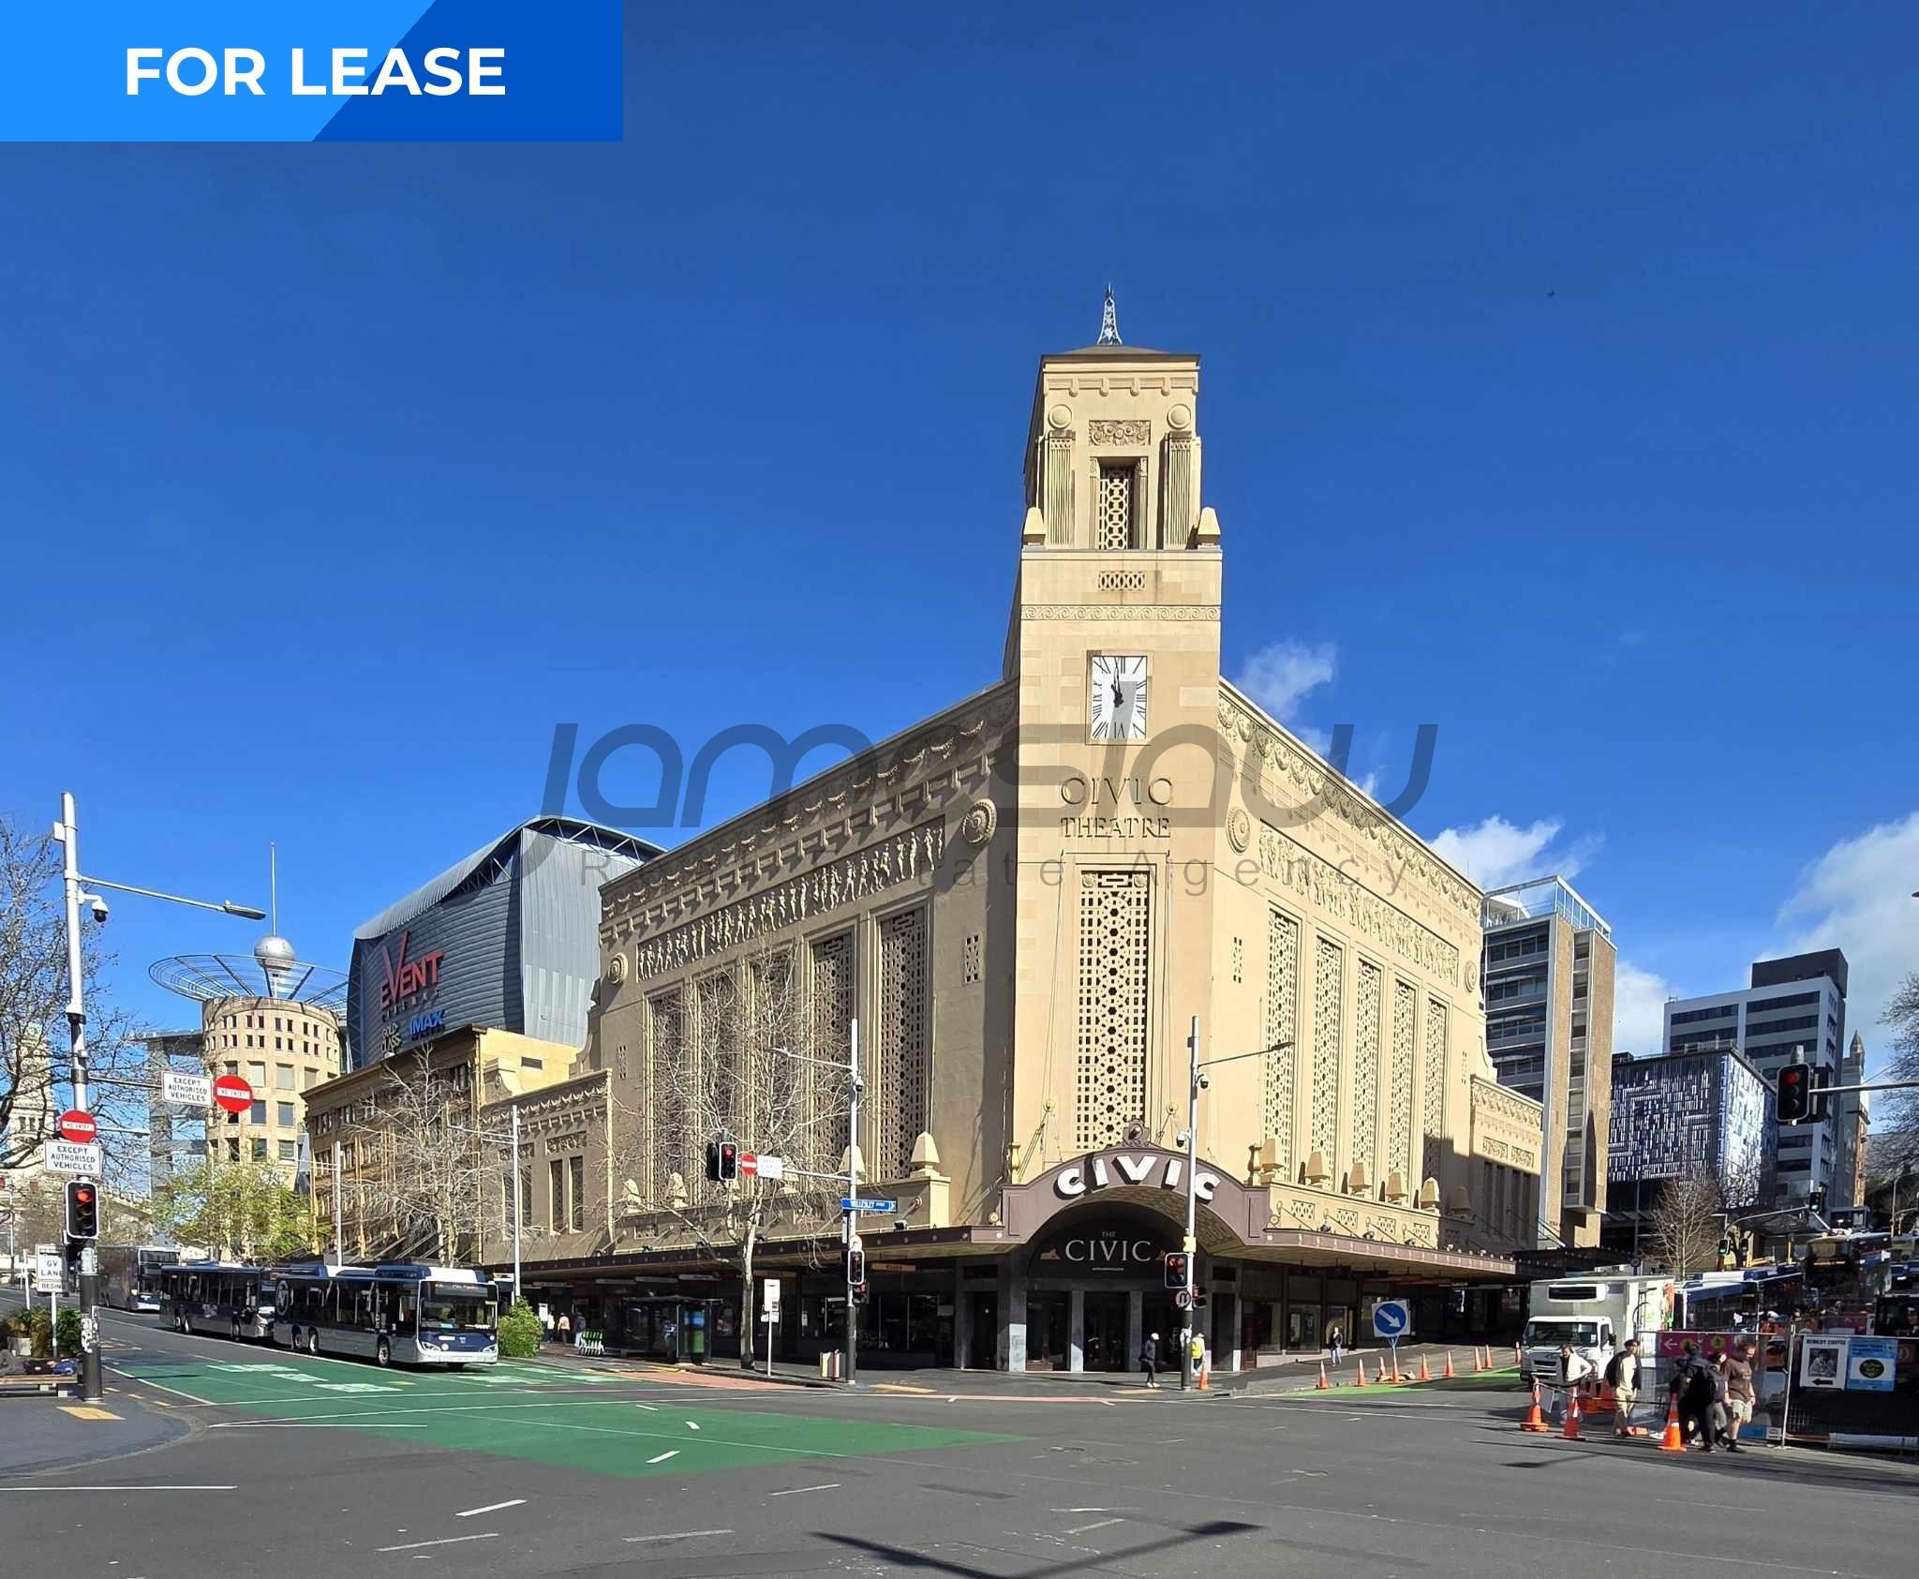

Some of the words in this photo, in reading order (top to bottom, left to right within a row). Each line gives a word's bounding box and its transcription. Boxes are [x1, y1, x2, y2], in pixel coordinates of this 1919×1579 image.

[1060, 777, 1173, 806] CIVIC
[1060, 816, 1172, 839] THEATRE
[378, 927, 447, 1010] EVENT
[173, 1076, 201, 1086] EXCEPT
[168, 1083, 208, 1096] AUTHORISED
[171, 1092, 207, 1102] VEHICLES
[57, 1145, 88, 1155] EXCEPT
[51, 1153, 96, 1164] AUTHORISED
[53, 1161, 94, 1171] VEHICLES
[1056, 1155, 1222, 1201] CIVIC
[1065, 1239, 1152, 1262] CIVIC
